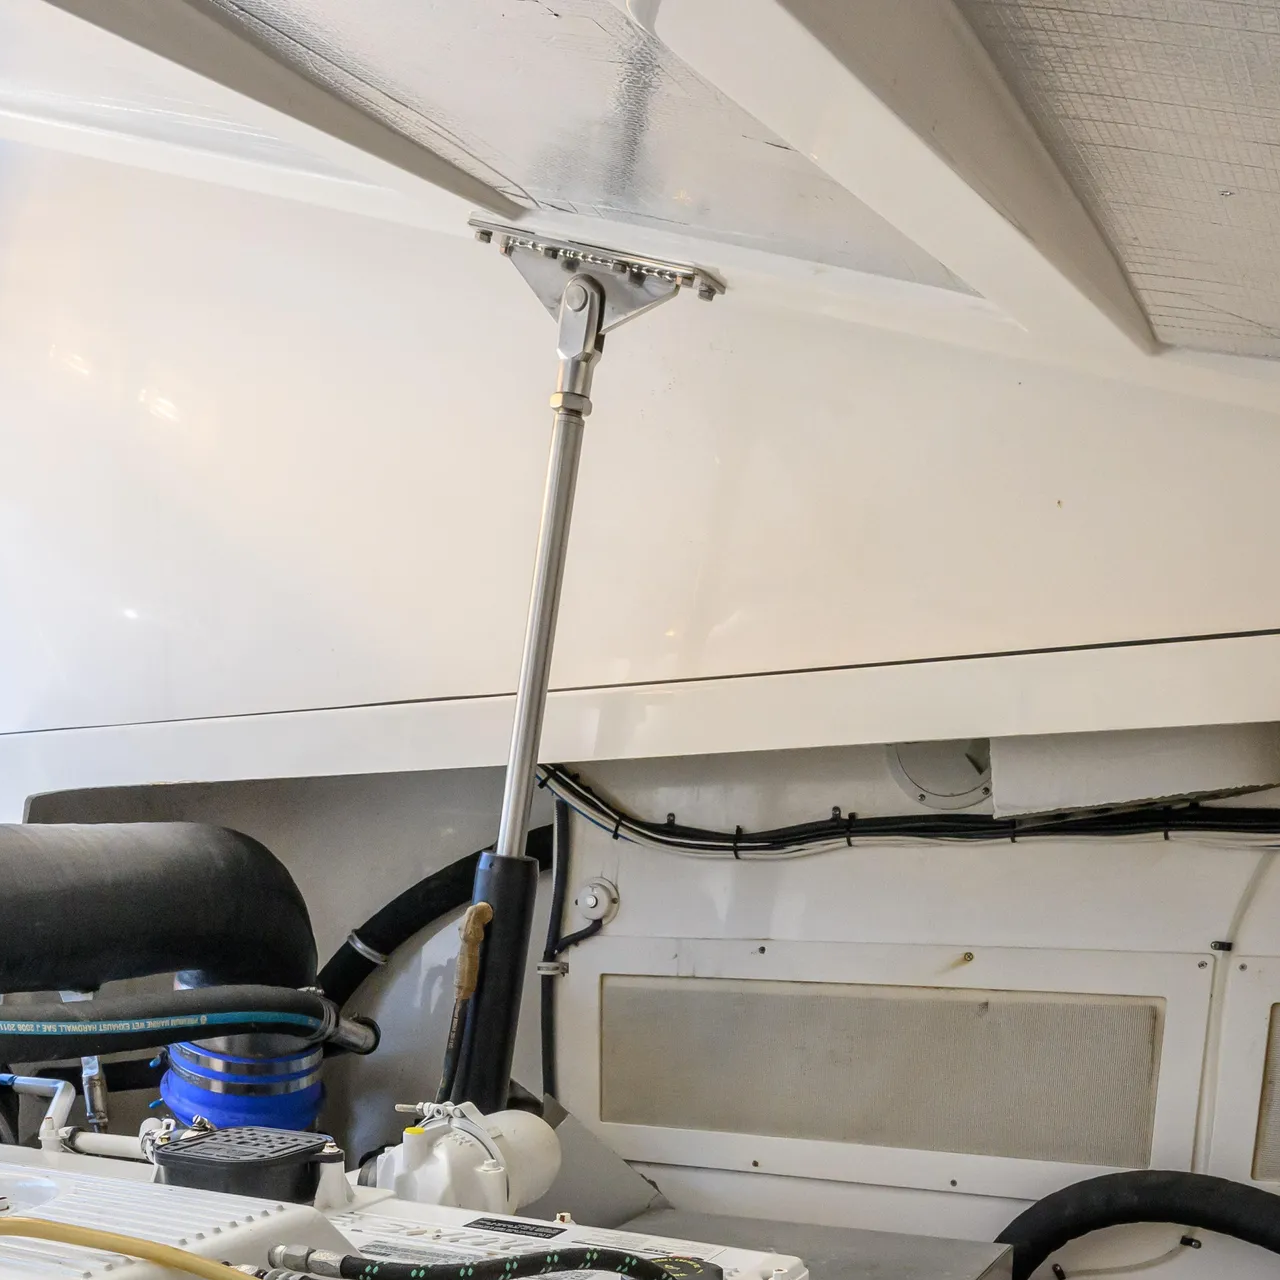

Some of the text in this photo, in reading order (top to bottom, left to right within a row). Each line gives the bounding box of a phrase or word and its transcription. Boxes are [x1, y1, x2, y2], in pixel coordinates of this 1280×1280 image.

[42, 1024, 57, 1032] SAE
[58, 1023, 97, 1033] HARDWALL
[98, 1022, 130, 1032] EXHAUST
